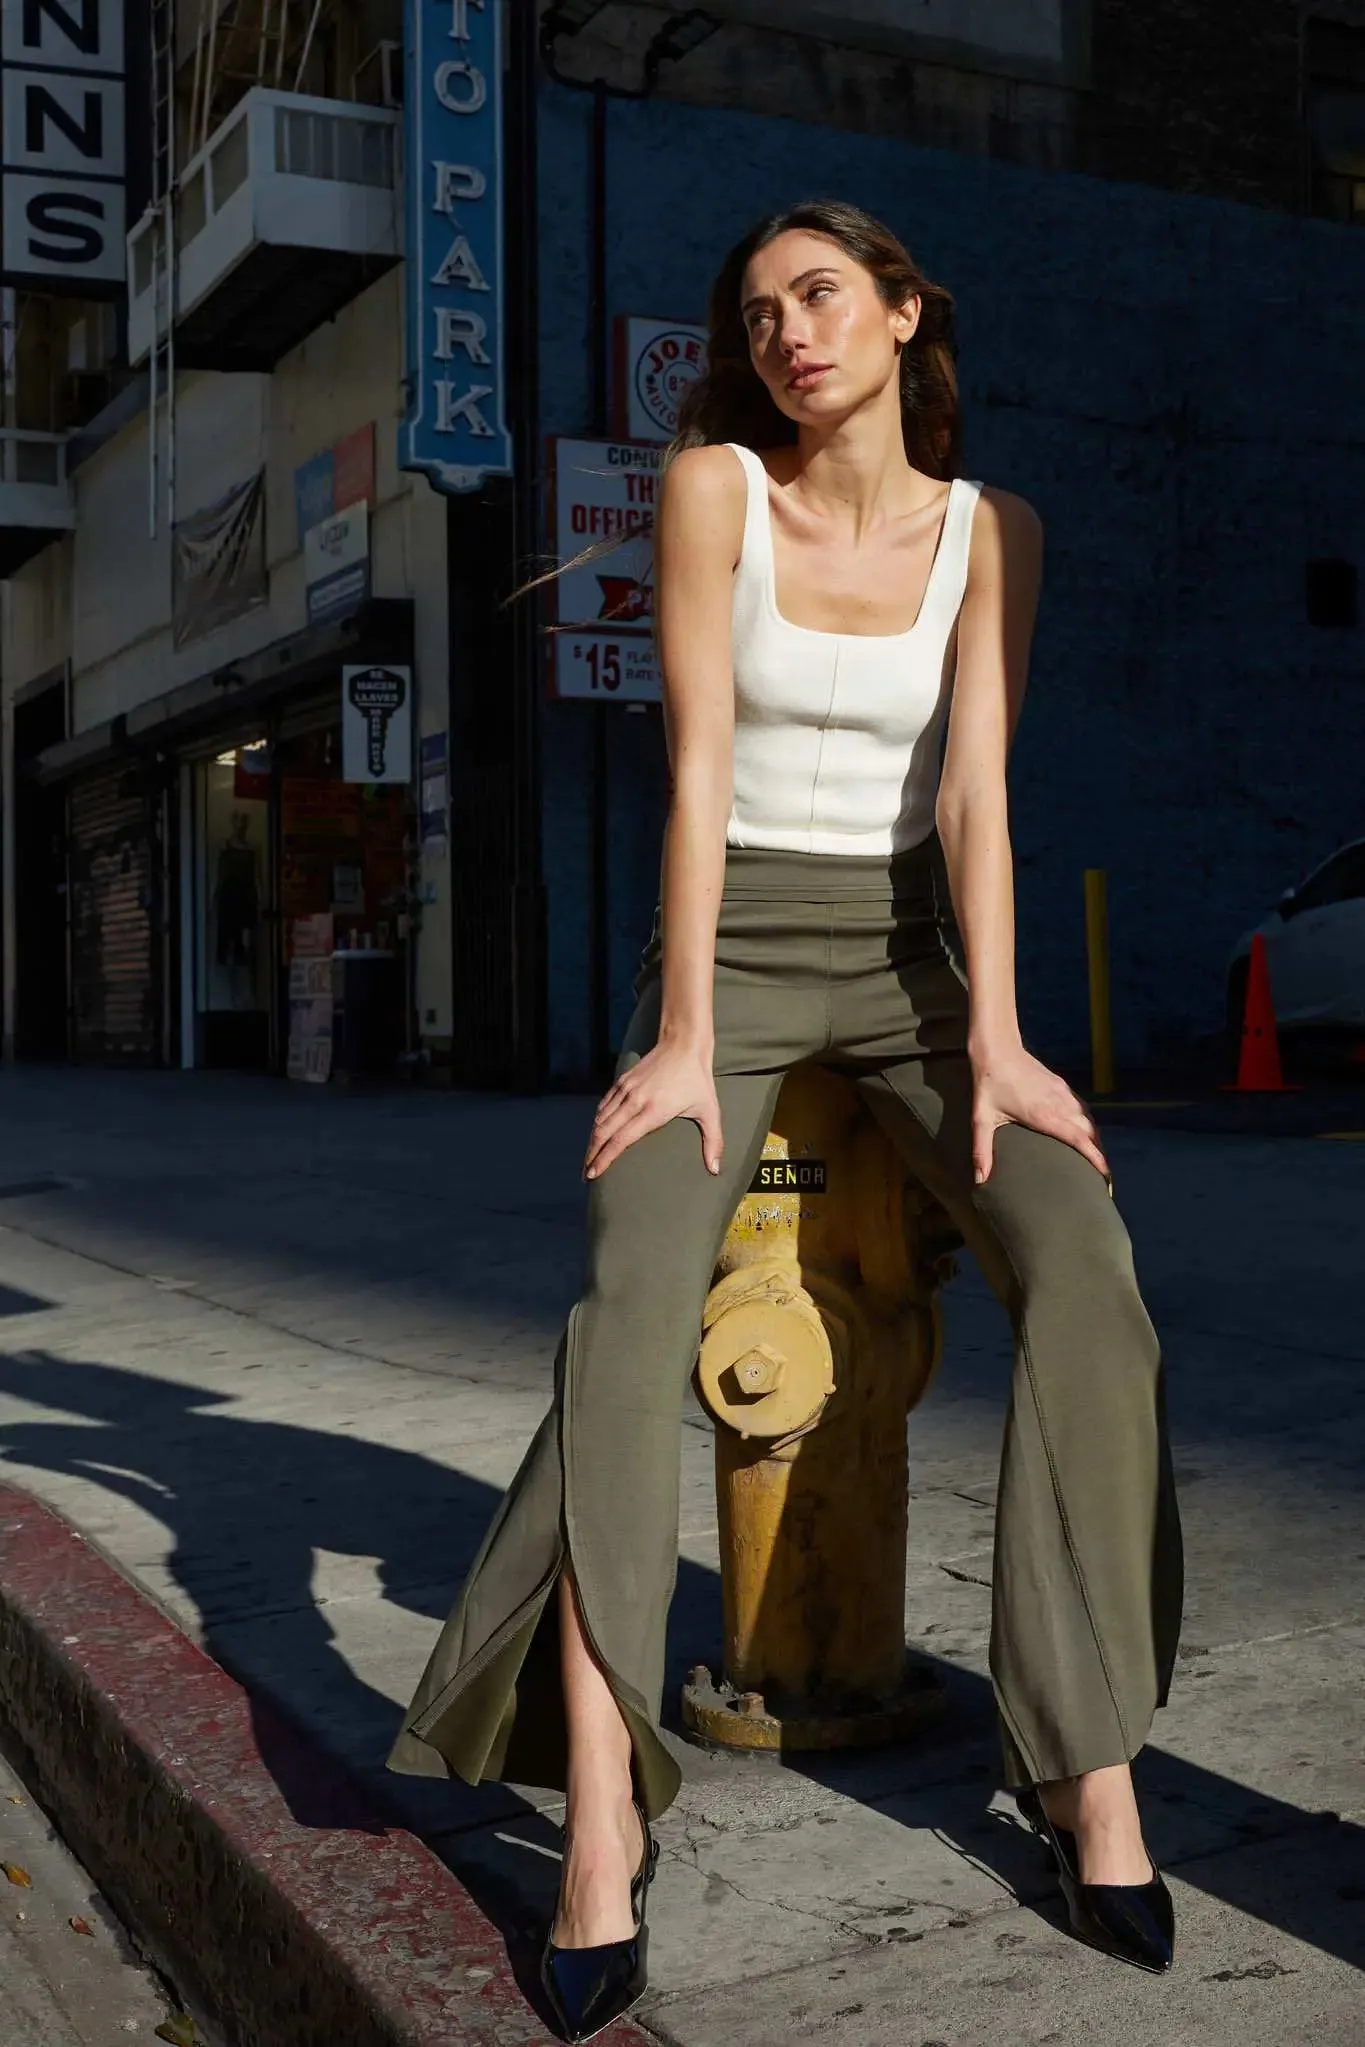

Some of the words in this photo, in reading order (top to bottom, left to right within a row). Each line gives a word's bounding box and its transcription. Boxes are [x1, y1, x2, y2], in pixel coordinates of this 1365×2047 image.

[430, 159, 496, 438] PARK
[648, 338, 702, 374] JOE
[573, 642, 621, 692] $15
[760, 1163, 824, 1185] SEÑOR
